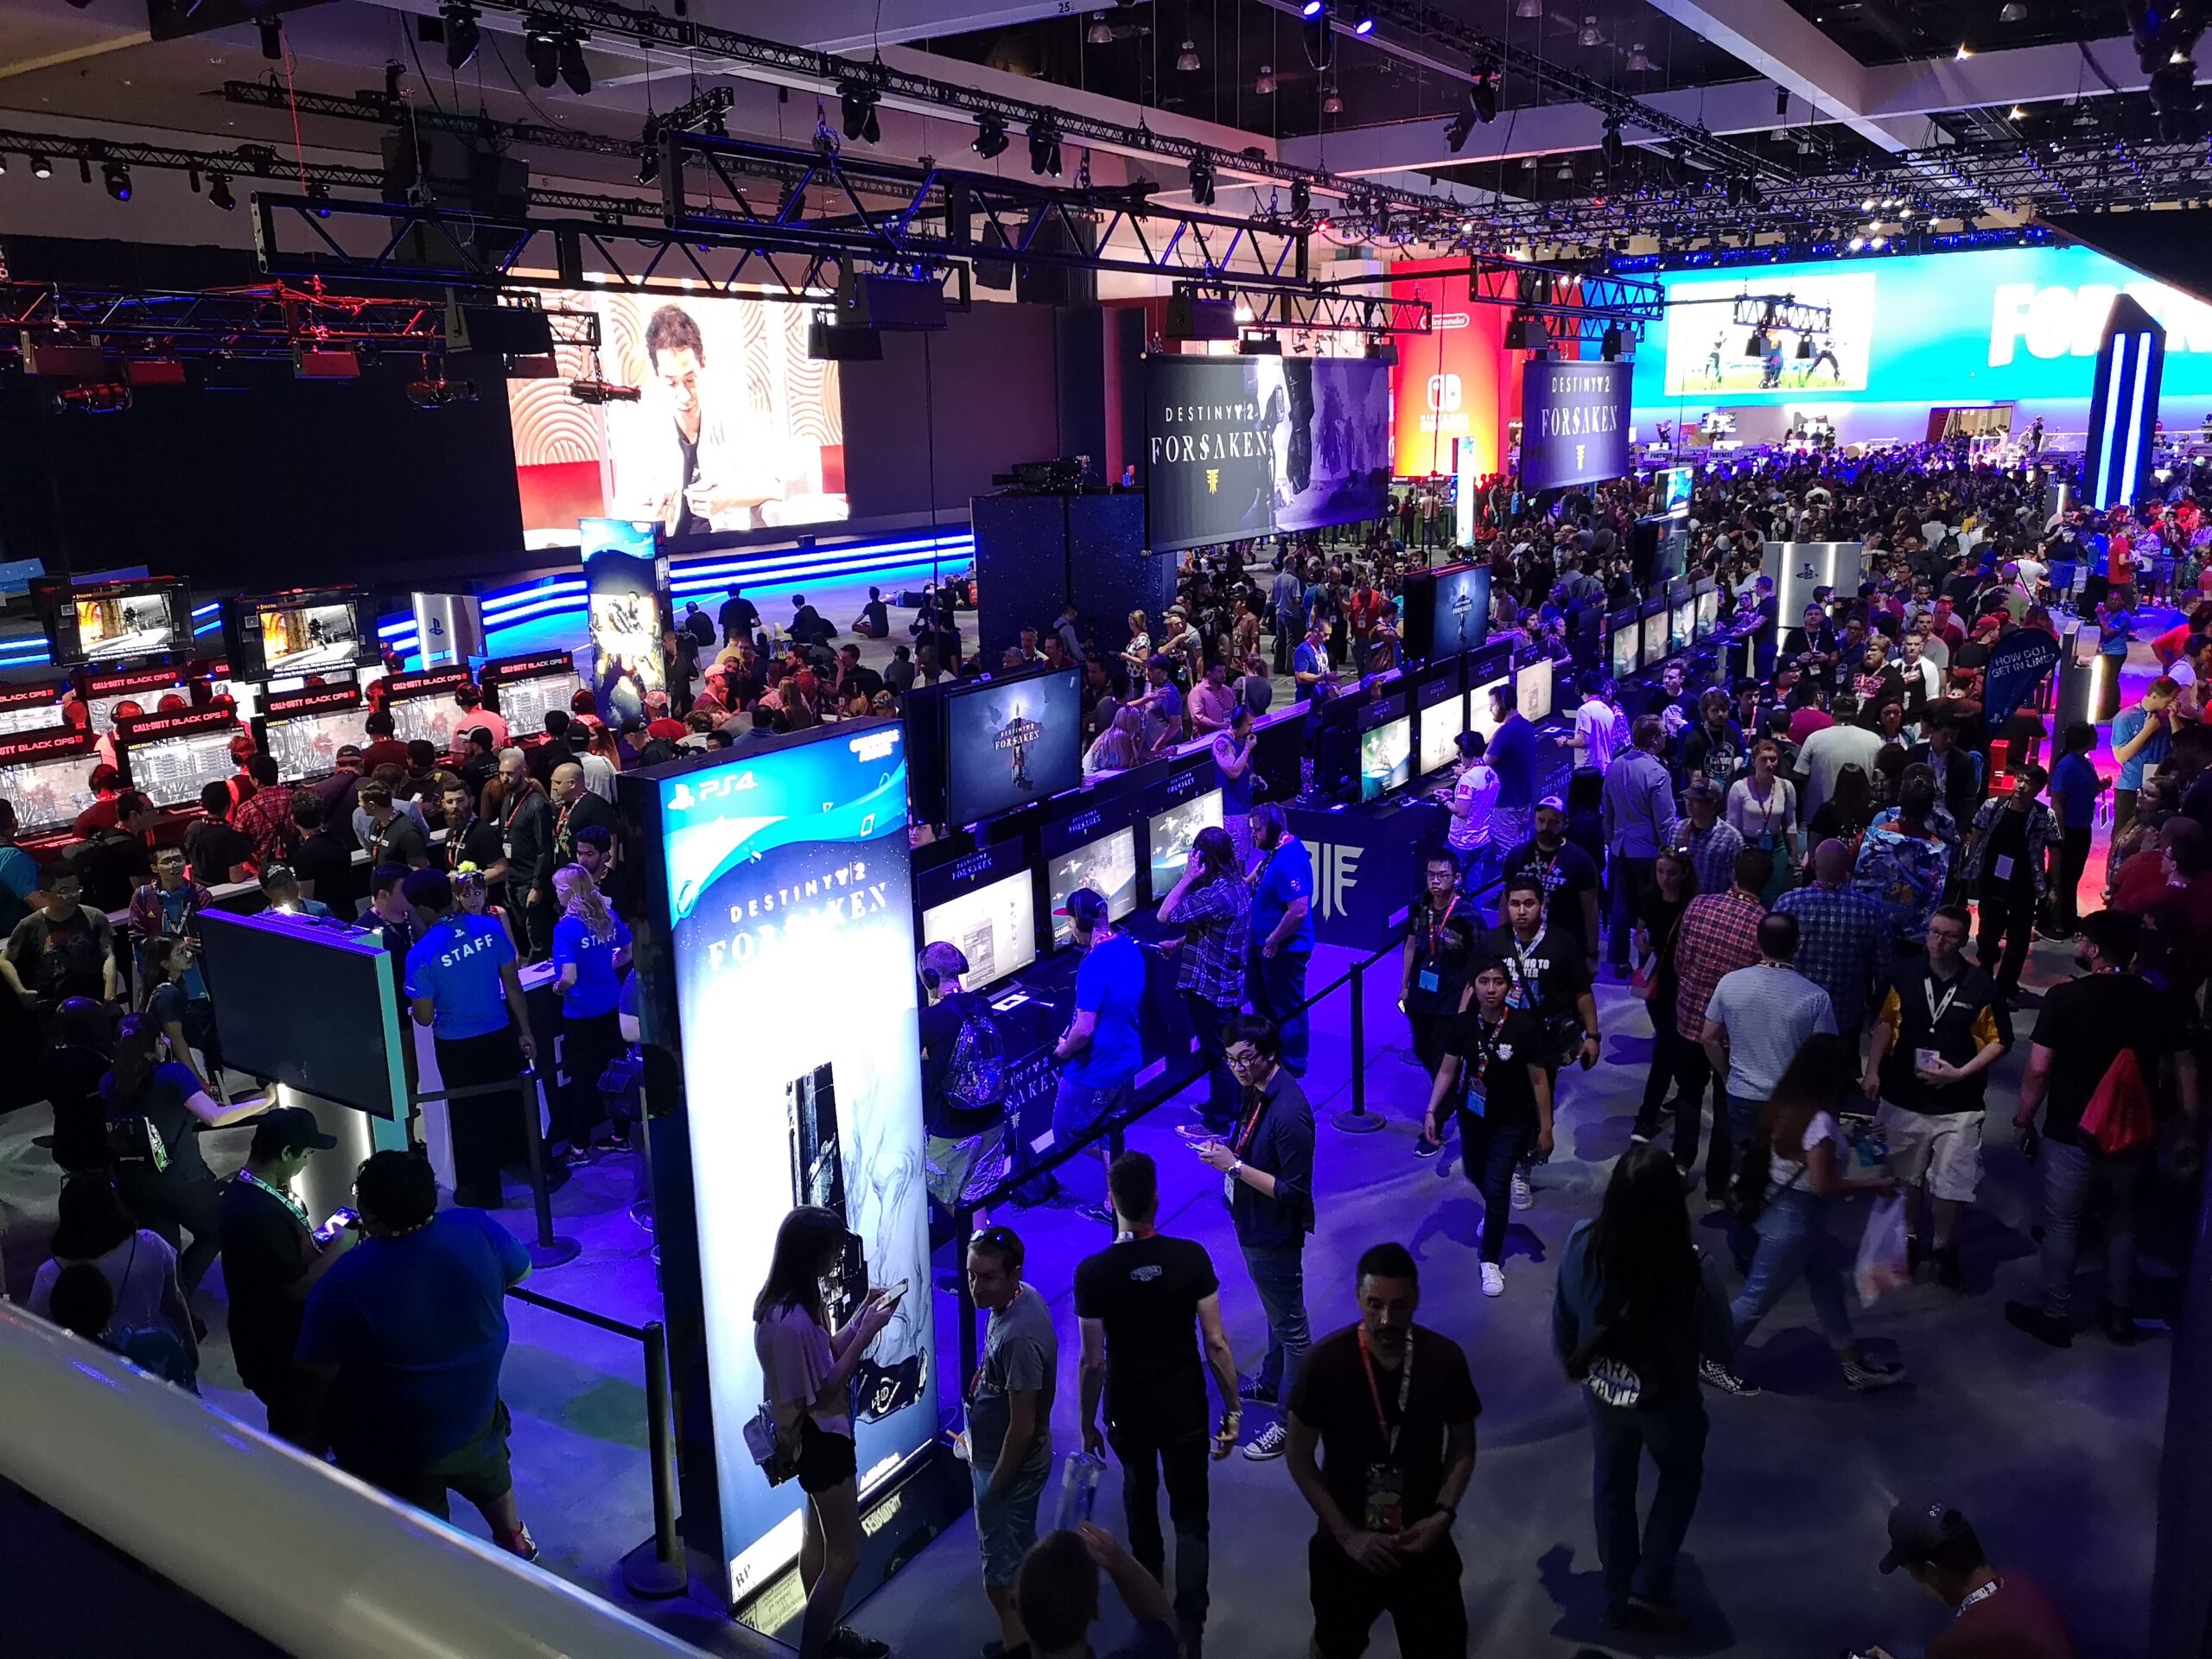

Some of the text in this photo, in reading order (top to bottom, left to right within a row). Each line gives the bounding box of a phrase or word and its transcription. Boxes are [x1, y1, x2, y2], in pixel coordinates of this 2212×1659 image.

[1058, 2, 1070, 13] 25
[1552, 376, 1596, 393] DESTINY
[1166, 403, 1254, 423] DESTINY 2
[1541, 404, 1618, 438] FORSAKEN
[1151, 430, 1268, 465] FORSAKEN
[500, 665, 514, 674] CALL
[528, 661, 550, 670] BLACK
[550, 658, 563, 666] OPS
[1995, 652, 2021, 667] HOW
[2024, 646, 2040, 658] DO
[1991, 664, 2011, 677] GET
[2012, 662, 2024, 671] IN
[92, 672, 169, 690] CALL DUTY BLACK OPS
[392, 682, 407, 691] CALL
[423, 677, 446, 686] BLACK
[447, 674, 461, 683] OPS
[29, 690, 47, 699] OPS
[270, 702, 286, 711] CALL
[305, 695, 330, 705] BLACK
[333, 691, 348, 701] OPS
[132, 711, 221, 733] CALL DUTY BLACK OPS
[18, 740, 53, 753] BLACK
[54, 736, 75, 747] OPS
[995, 729, 1040, 750] FORSAKEN
[699, 772, 759, 802] PS4
[729, 861, 865, 925] DESTINY 2
[441, 933, 494, 968] STAFF
